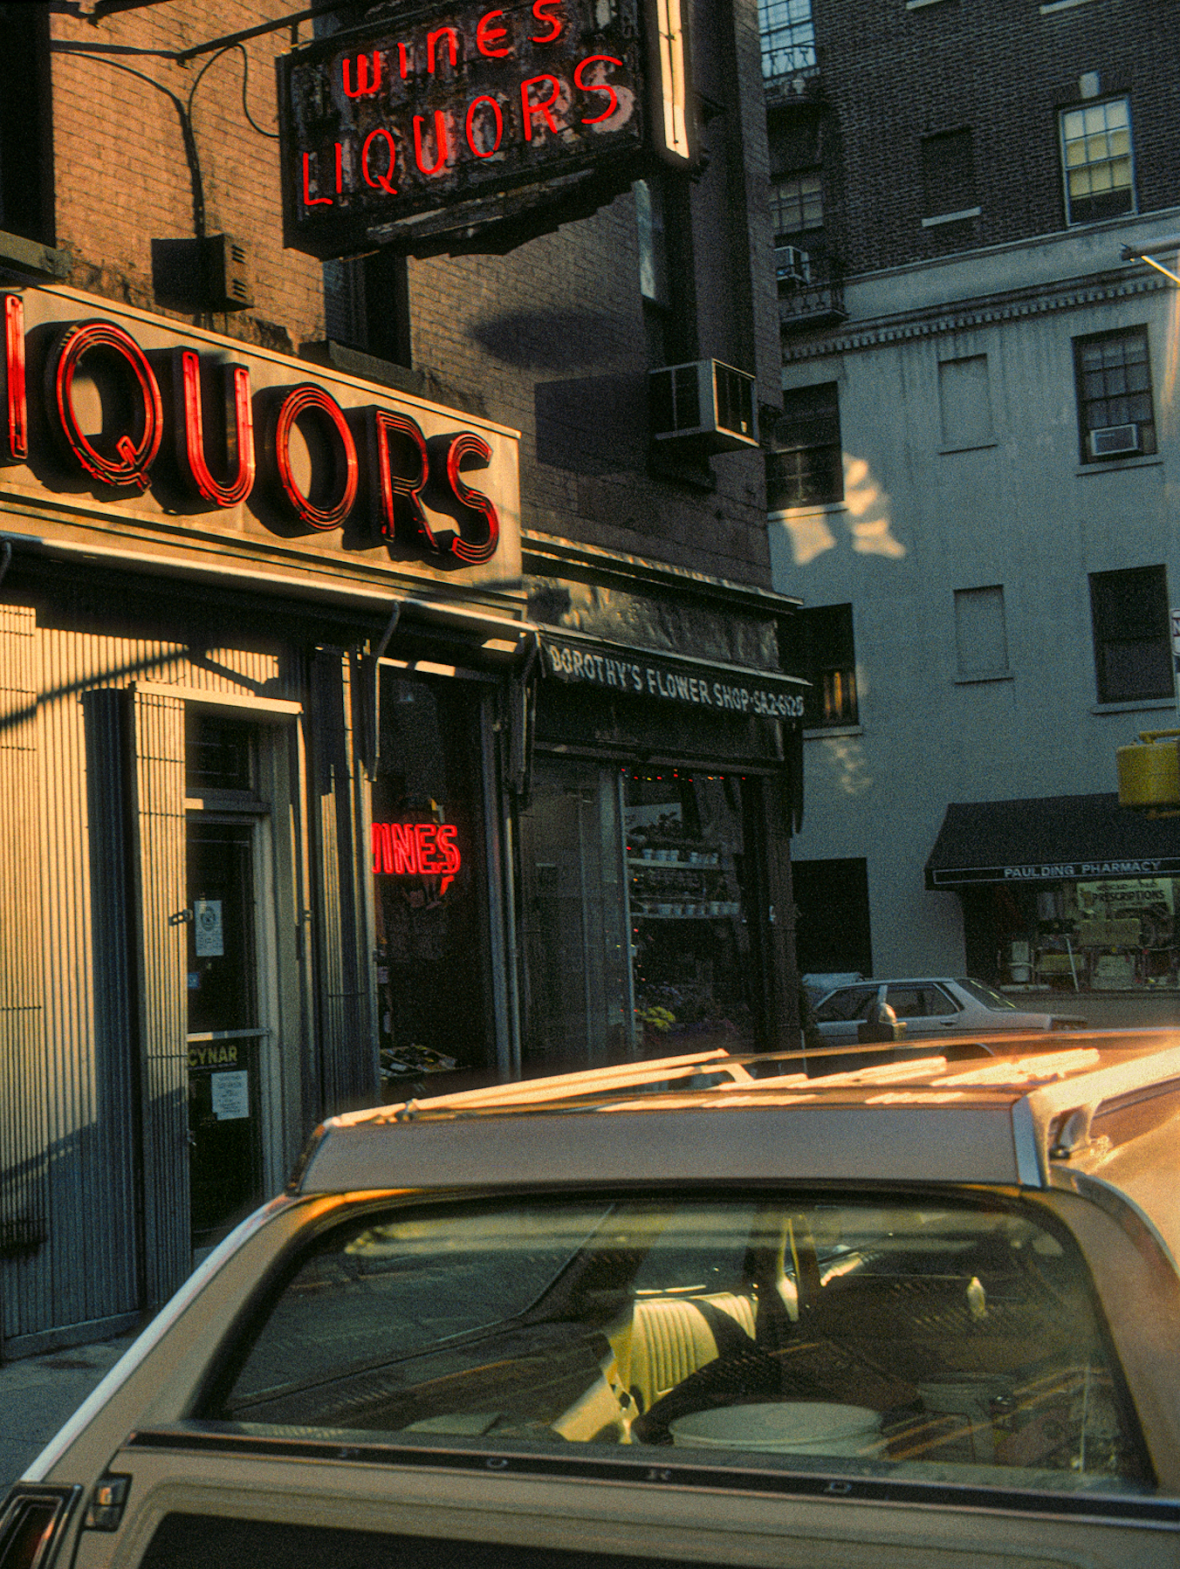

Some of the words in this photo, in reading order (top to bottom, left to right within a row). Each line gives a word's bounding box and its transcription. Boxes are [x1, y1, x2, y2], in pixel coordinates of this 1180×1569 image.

[303, 55, 623, 206] LIQUORS
[549, 644, 643, 691] DOROTHY'S
[646, 668, 712, 705] FLOWER
[1004, 865, 1075, 879] PAULDING
[1082, 860, 1162, 875] PHARMACY
[187, 1044, 238, 1068] CYNAR
